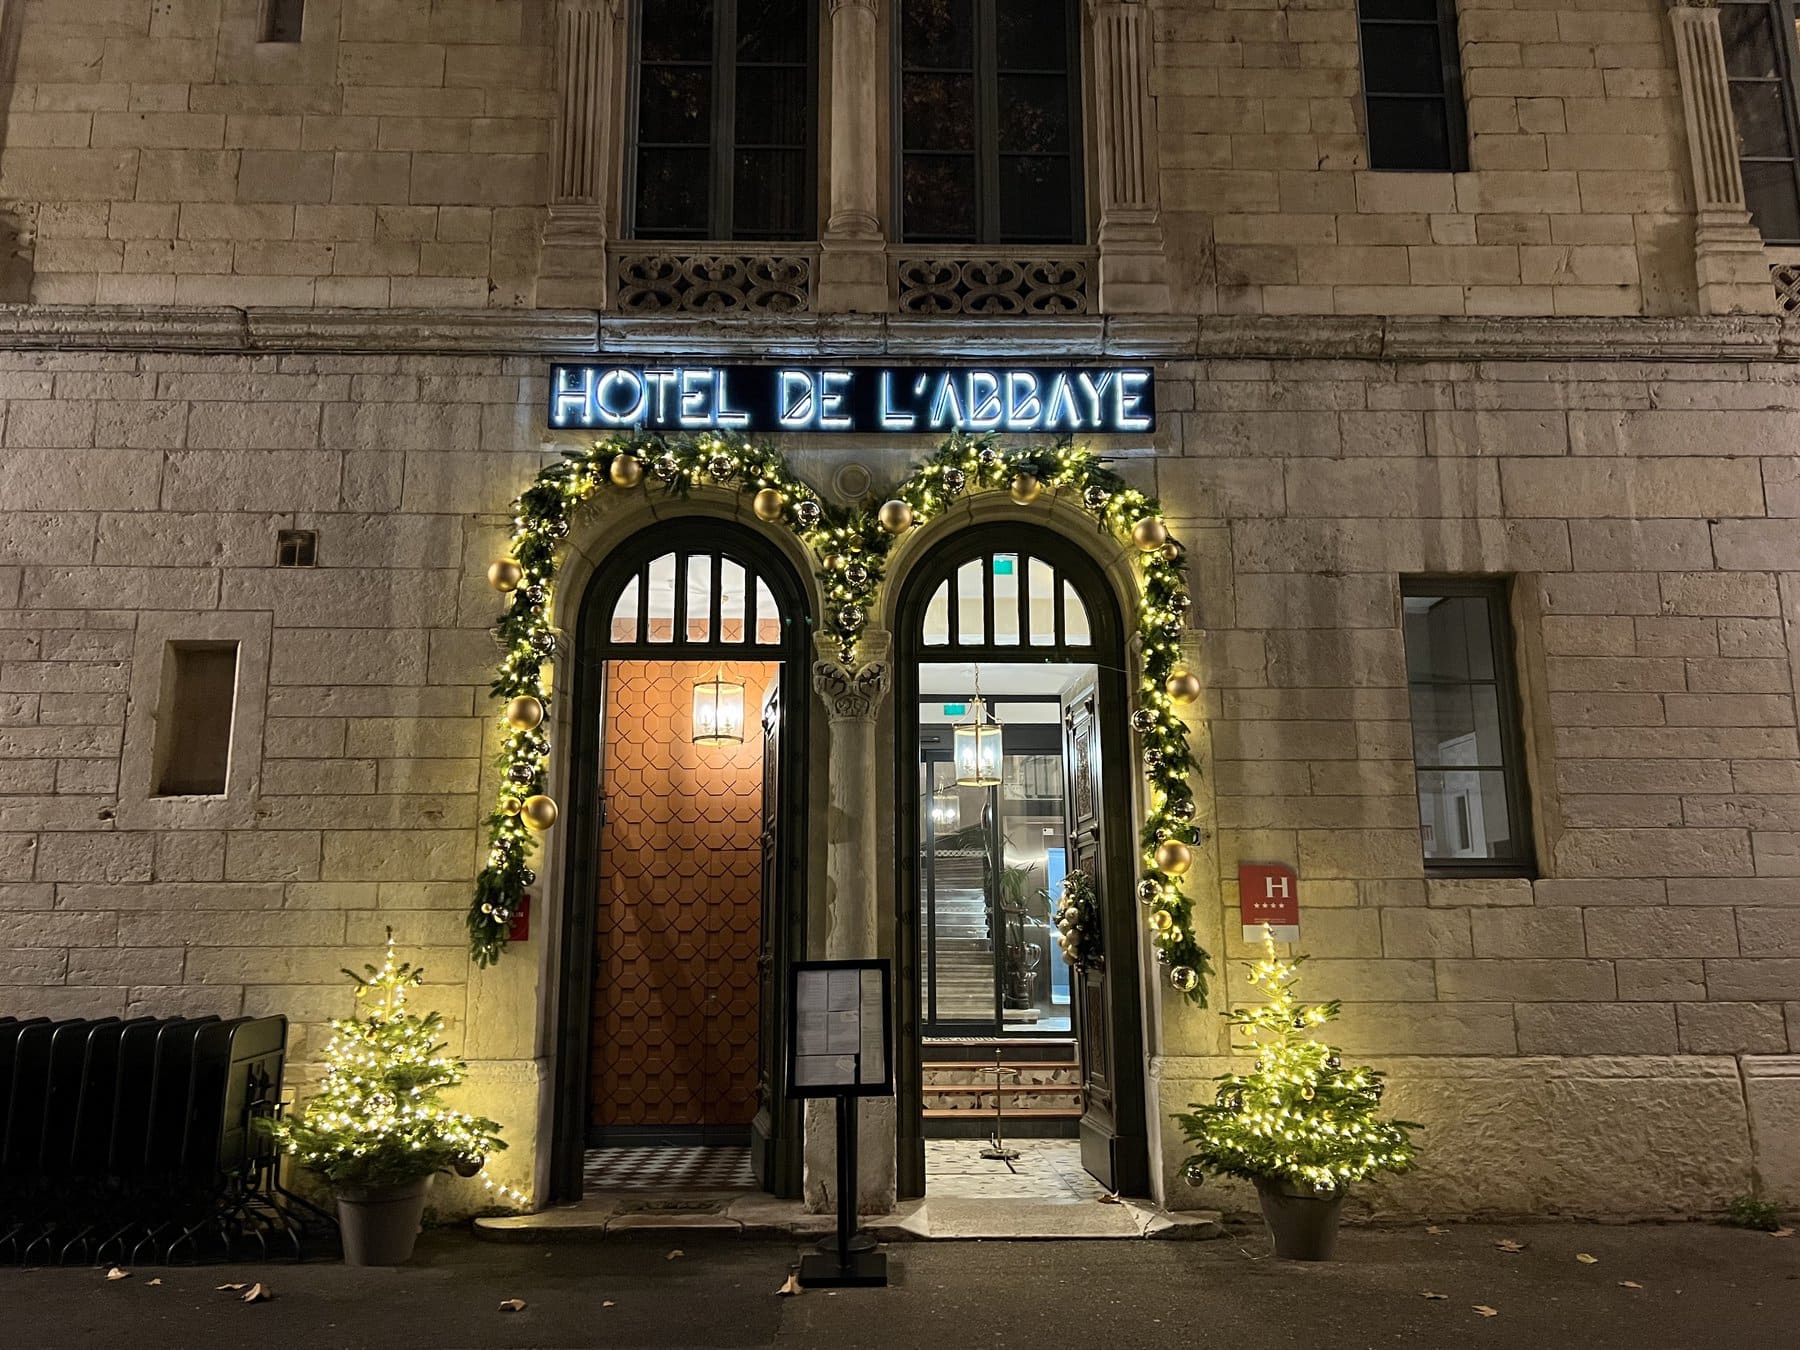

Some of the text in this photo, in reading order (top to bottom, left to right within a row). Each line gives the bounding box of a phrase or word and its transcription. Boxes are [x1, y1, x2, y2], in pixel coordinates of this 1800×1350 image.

[555, 368, 1151, 427] HOTEL DE L'ABBAYE
[1265, 876, 1289, 898] H
